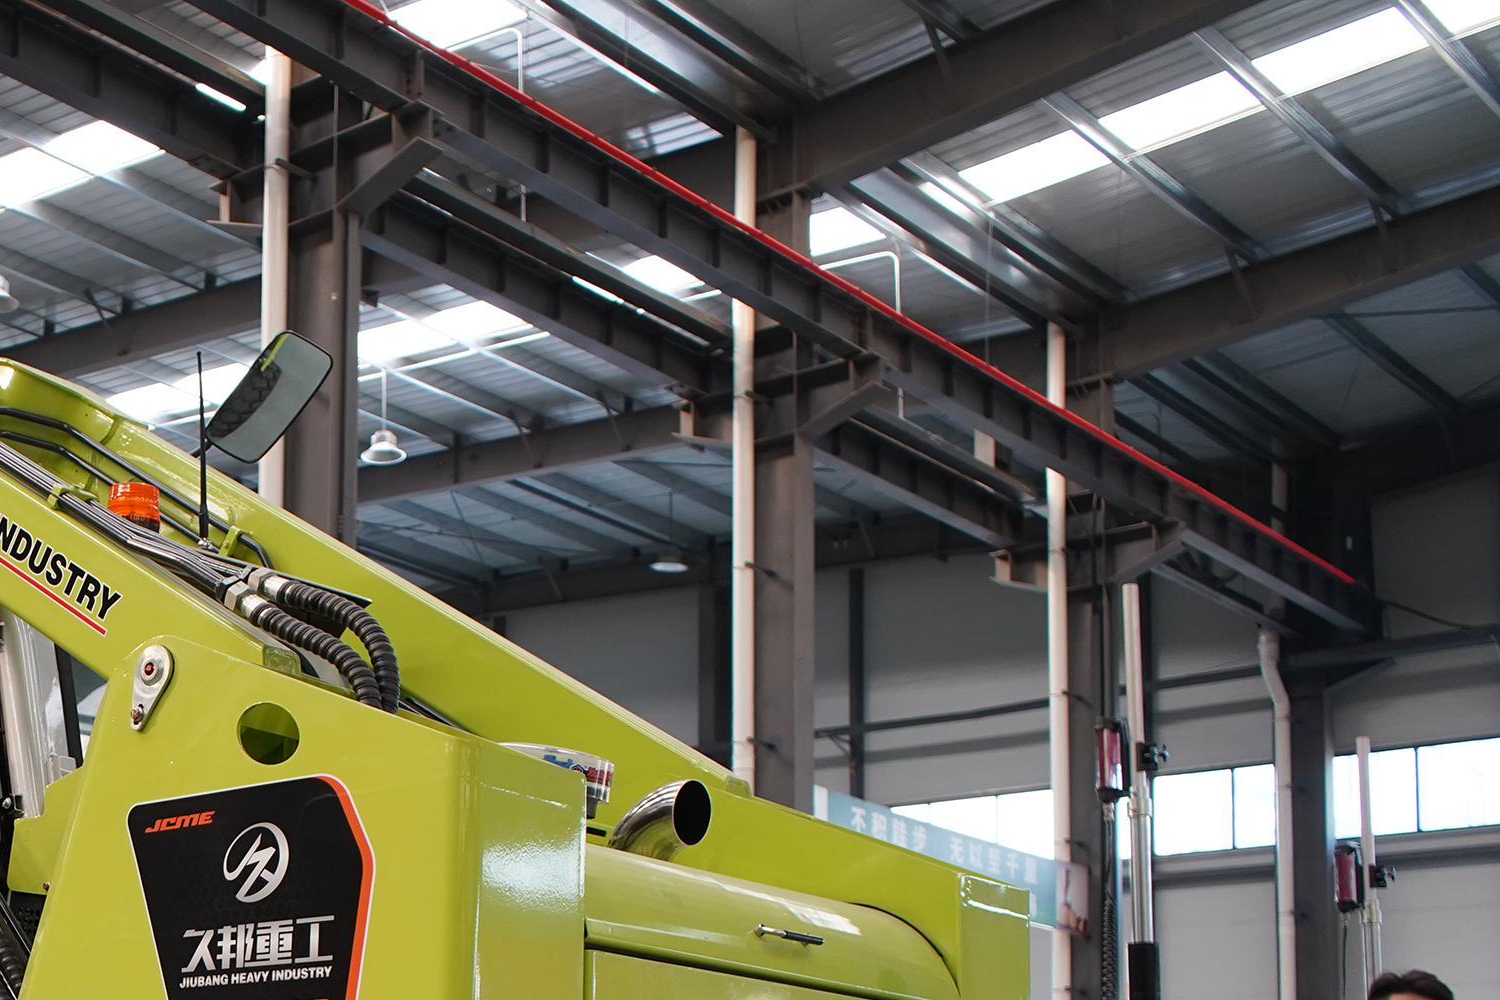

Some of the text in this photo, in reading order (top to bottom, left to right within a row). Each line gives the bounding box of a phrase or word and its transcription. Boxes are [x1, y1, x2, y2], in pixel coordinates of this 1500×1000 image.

[144, 810, 216, 834] JCME
[950, 836, 1039, 885] 无以至千里
[181, 915, 335, 974] 久邦重工
[179, 966, 333, 989] JIUBANG HEAVY INDUSTRY
